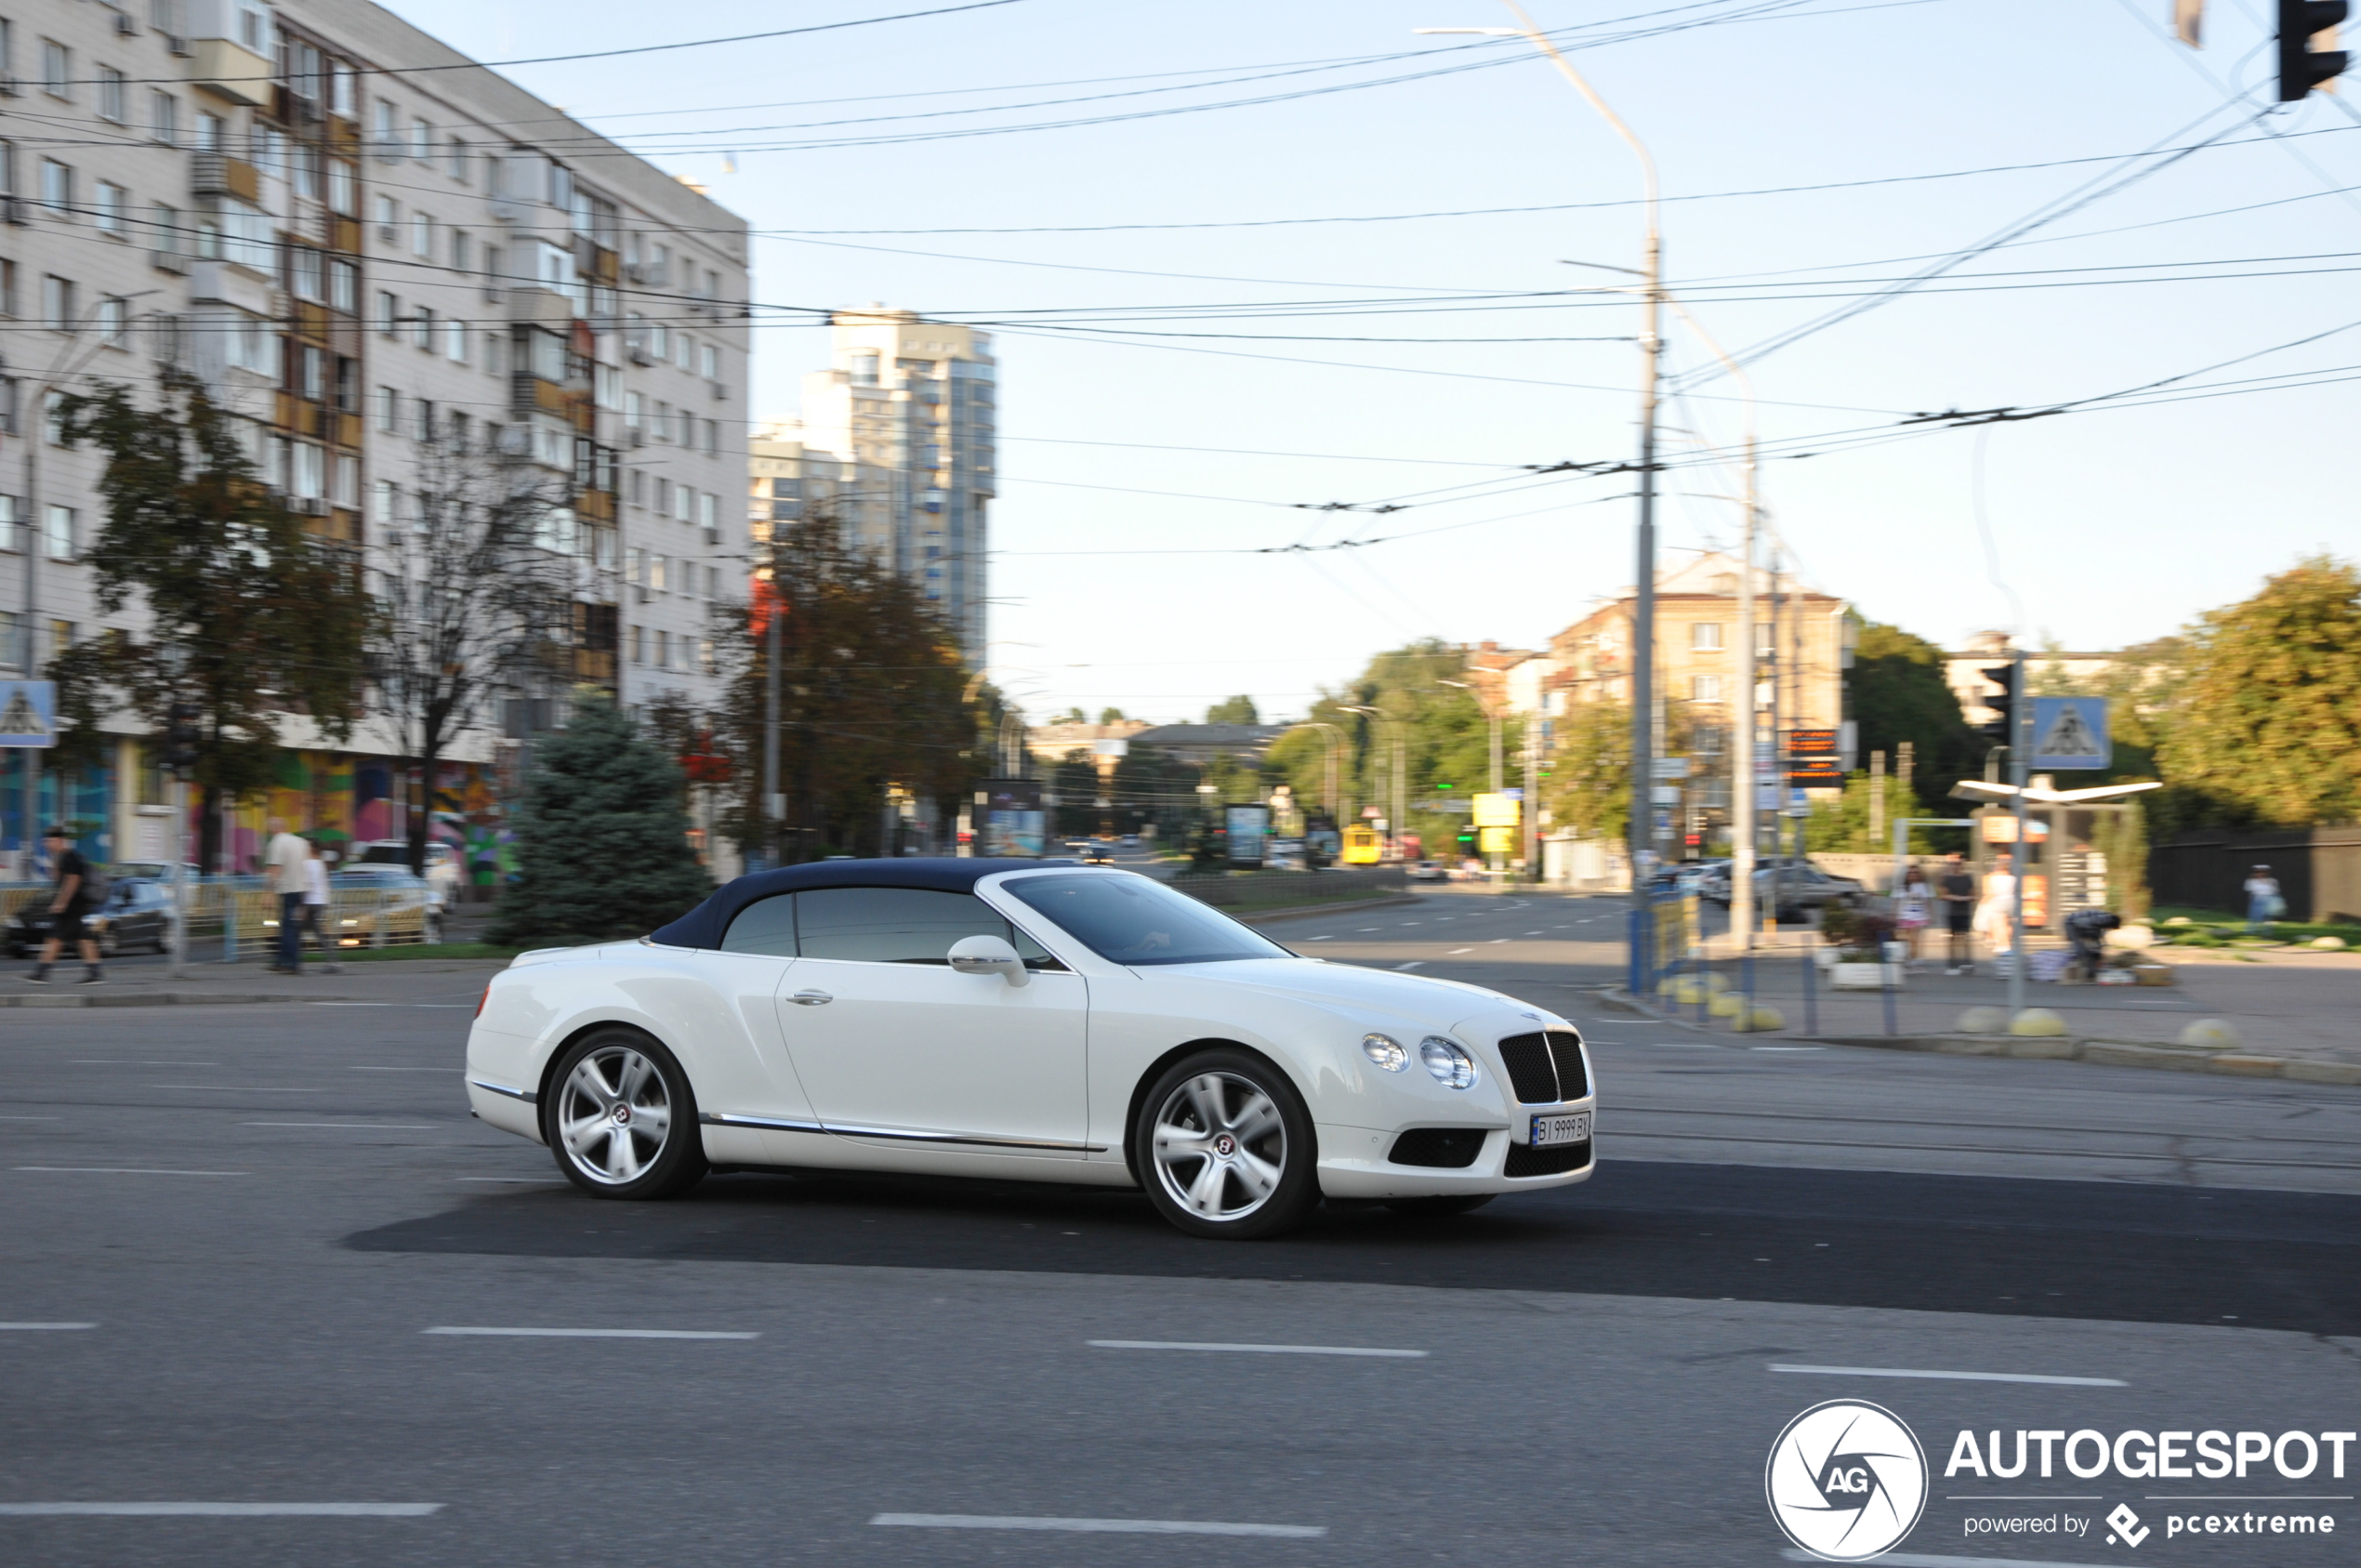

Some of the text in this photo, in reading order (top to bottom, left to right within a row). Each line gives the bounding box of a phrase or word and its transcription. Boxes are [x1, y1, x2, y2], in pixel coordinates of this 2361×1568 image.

[1538, 1117, 1589, 1140] BI 9999 BX
